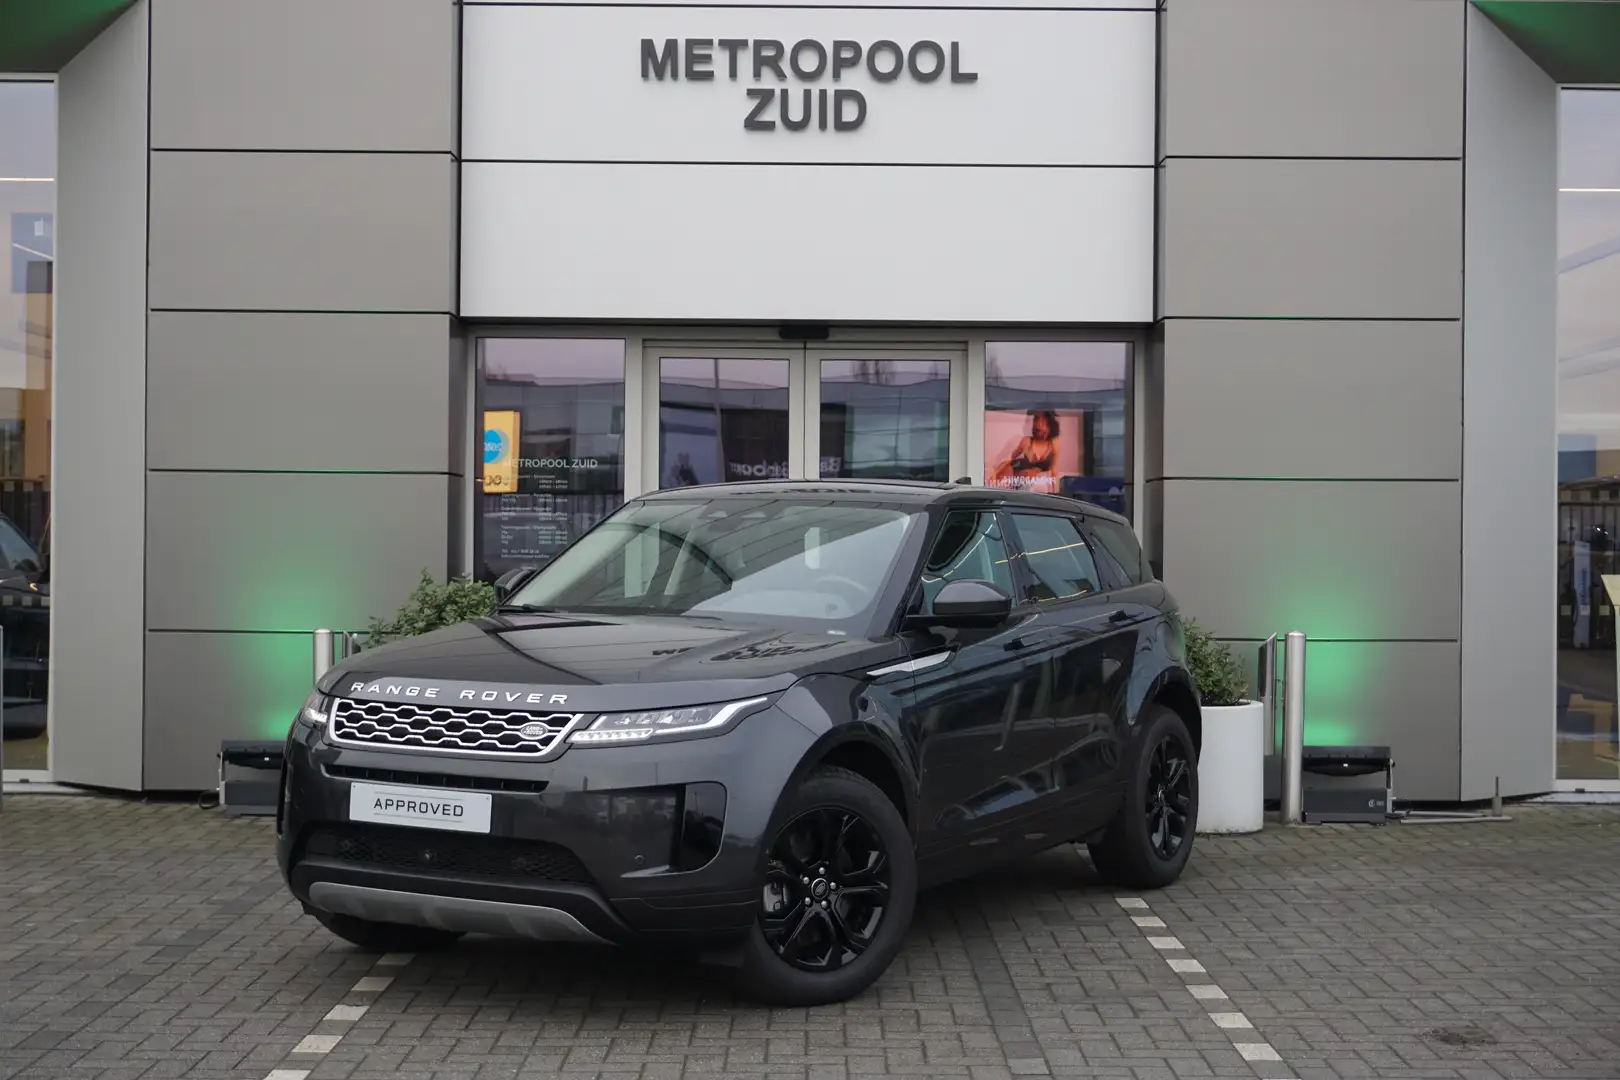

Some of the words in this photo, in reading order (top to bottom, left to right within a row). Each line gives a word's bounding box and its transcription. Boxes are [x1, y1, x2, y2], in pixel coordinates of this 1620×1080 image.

[640, 38, 978, 83] METROPOOL
[744, 88, 867, 131] ZUID
[571, 458, 598, 469] ZUID
[351, 682, 440, 698] RANGE
[459, 690, 568, 704] ROVER
[374, 798, 464, 817] APPROVED
